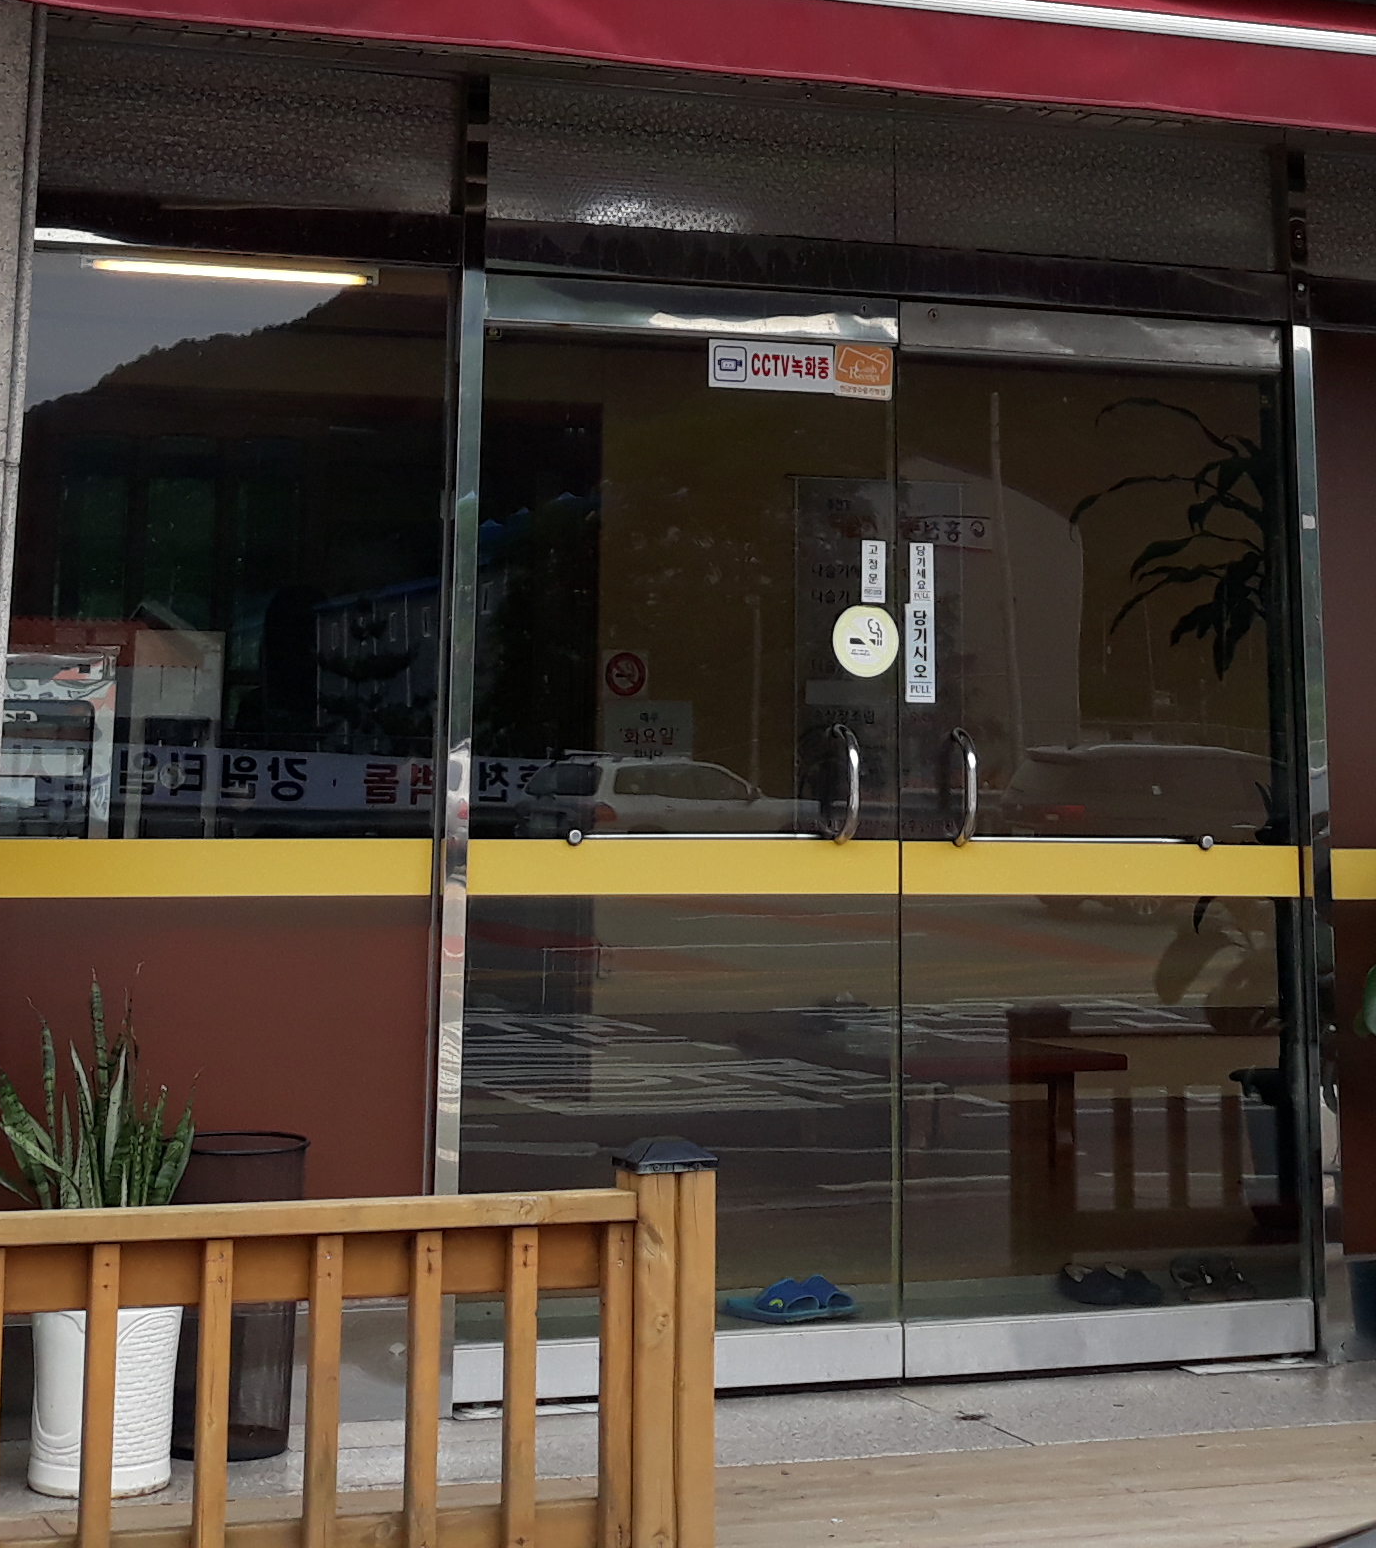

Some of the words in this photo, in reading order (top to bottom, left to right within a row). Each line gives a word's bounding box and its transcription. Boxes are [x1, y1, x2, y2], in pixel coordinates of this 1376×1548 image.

[914, 545, 927, 590] 당기세요
[912, 609, 929, 679] 당기시오
[910, 684, 932, 695] PULL
